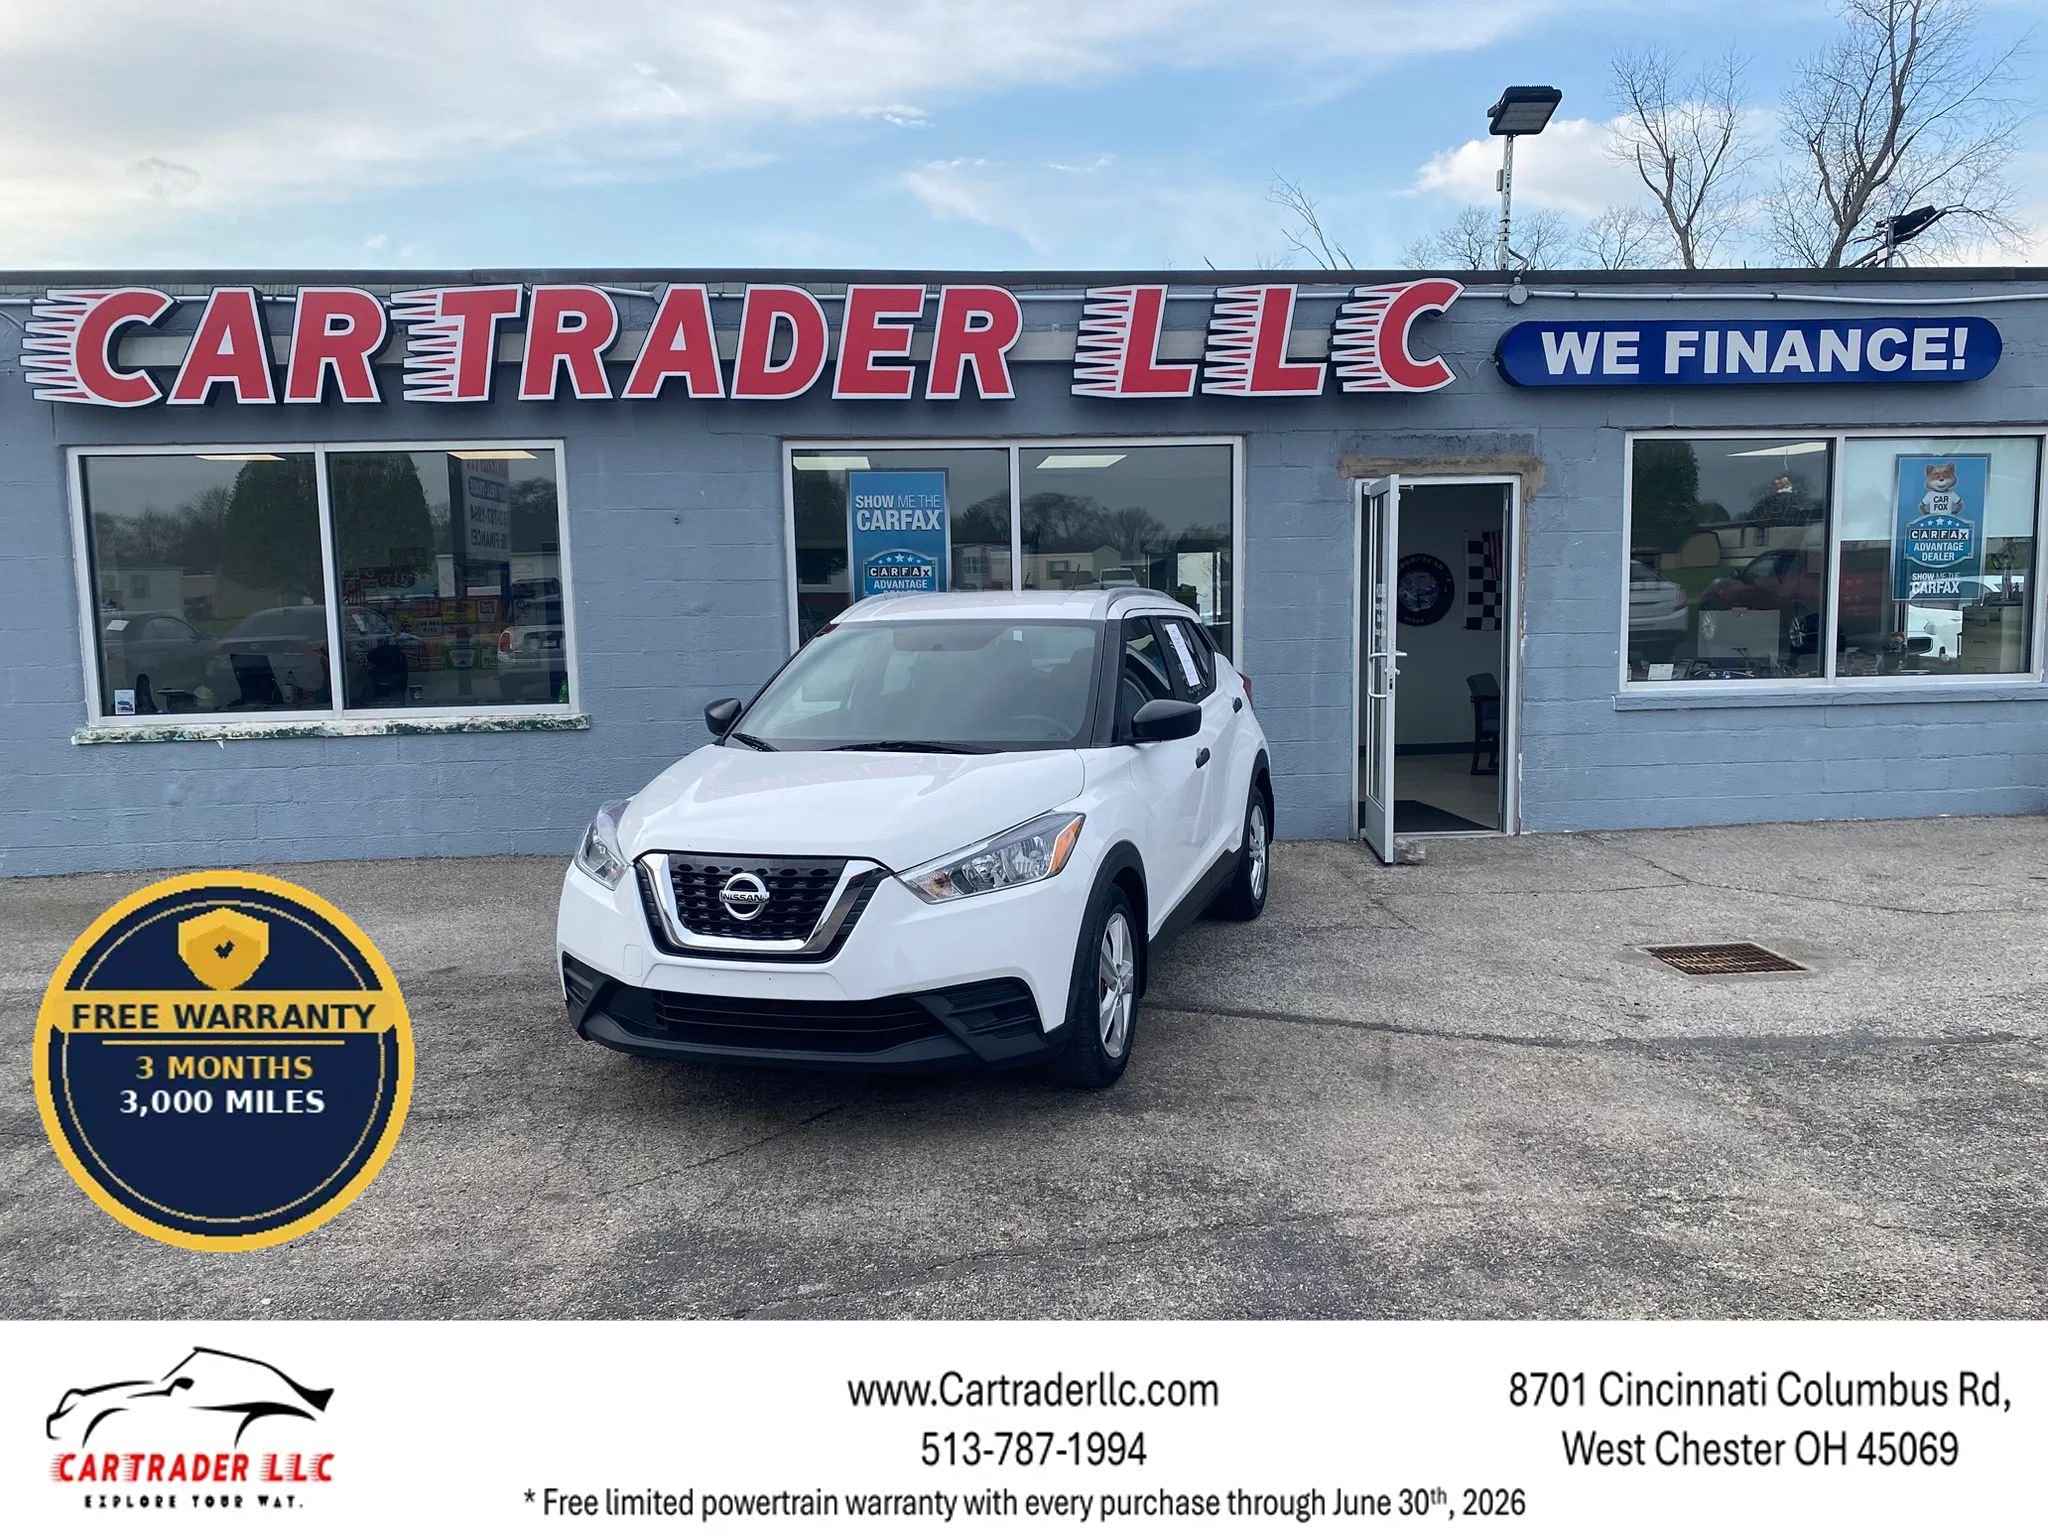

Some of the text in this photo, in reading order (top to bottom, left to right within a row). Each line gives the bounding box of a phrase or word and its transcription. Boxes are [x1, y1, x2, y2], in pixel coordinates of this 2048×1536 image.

[20, 278, 1465, 408] CAR TRADER LLC
[1541, 326, 1970, 375] WE FINANCE!
[855, 495, 940, 508] SHOW ME THE
[856, 509, 941, 531] CARFAX
[1911, 529, 1968, 540] CARFAX
[1914, 542, 1964, 551] ADVANTAGE
[1922, 552, 1955, 561] DEALER
[868, 566, 932, 577] CARFAX
[1912, 573, 1937, 581] SHOW
[873, 580, 928, 589] ADVANTAGE
[1911, 582, 1960, 594] CARFAX
[723, 893, 767, 902] NISSAN
